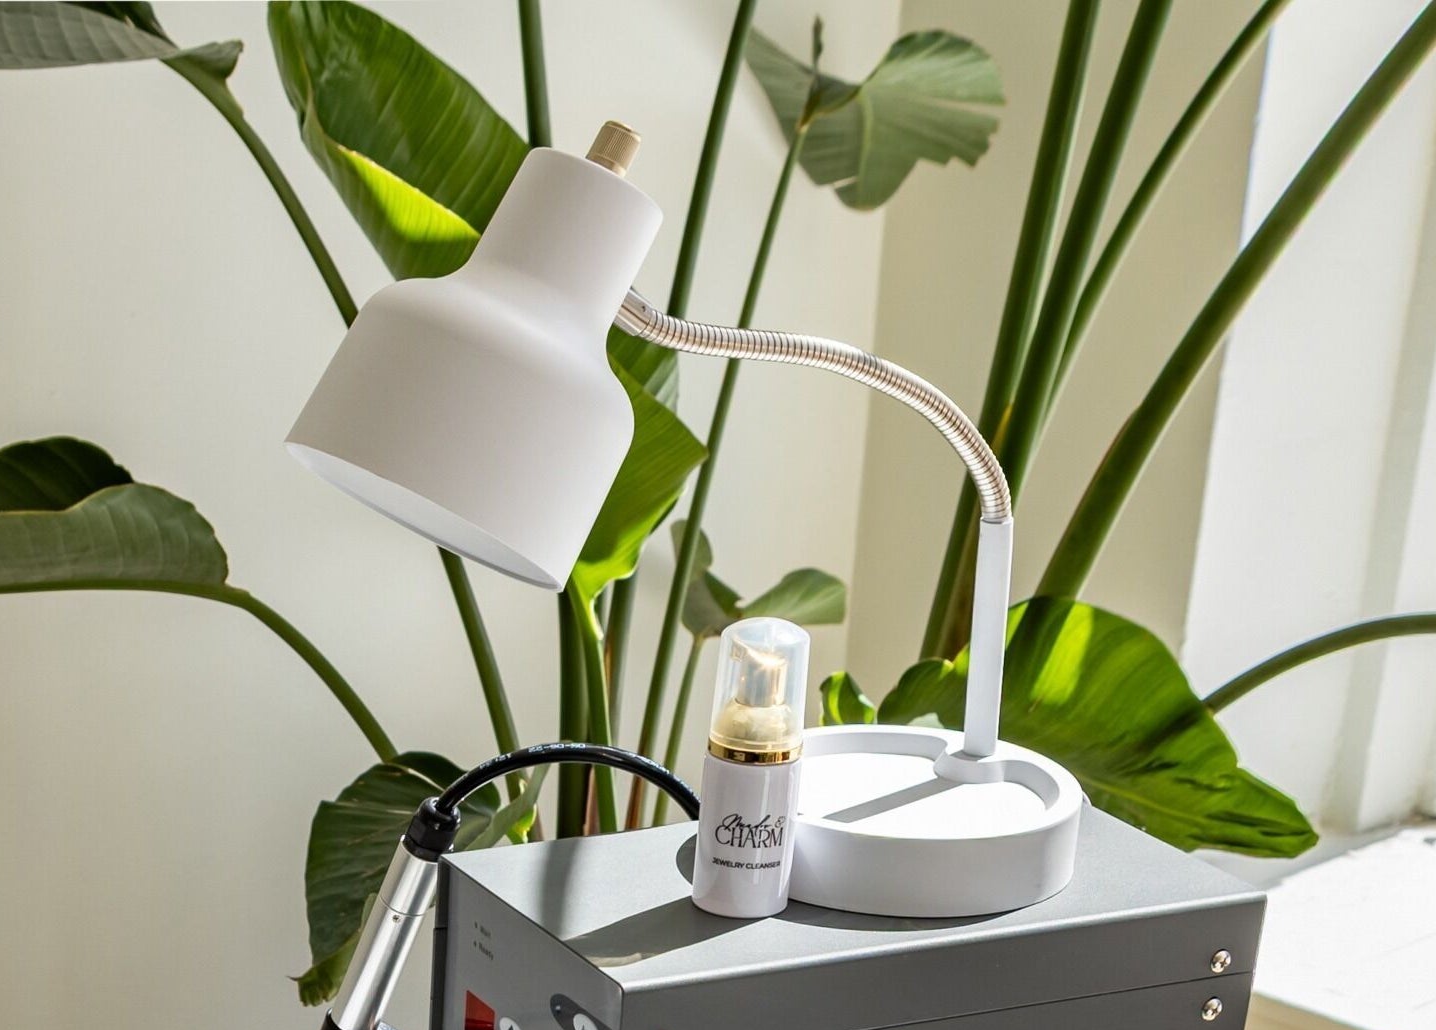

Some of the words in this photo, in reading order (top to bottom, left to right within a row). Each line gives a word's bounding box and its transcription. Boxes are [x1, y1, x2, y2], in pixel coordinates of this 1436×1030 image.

[774, 815, 786, 829] &
[715, 825, 783, 849] CHARM
[712, 857, 745, 869] JEWELRY
[745, 860, 781, 870] CLEANSER
